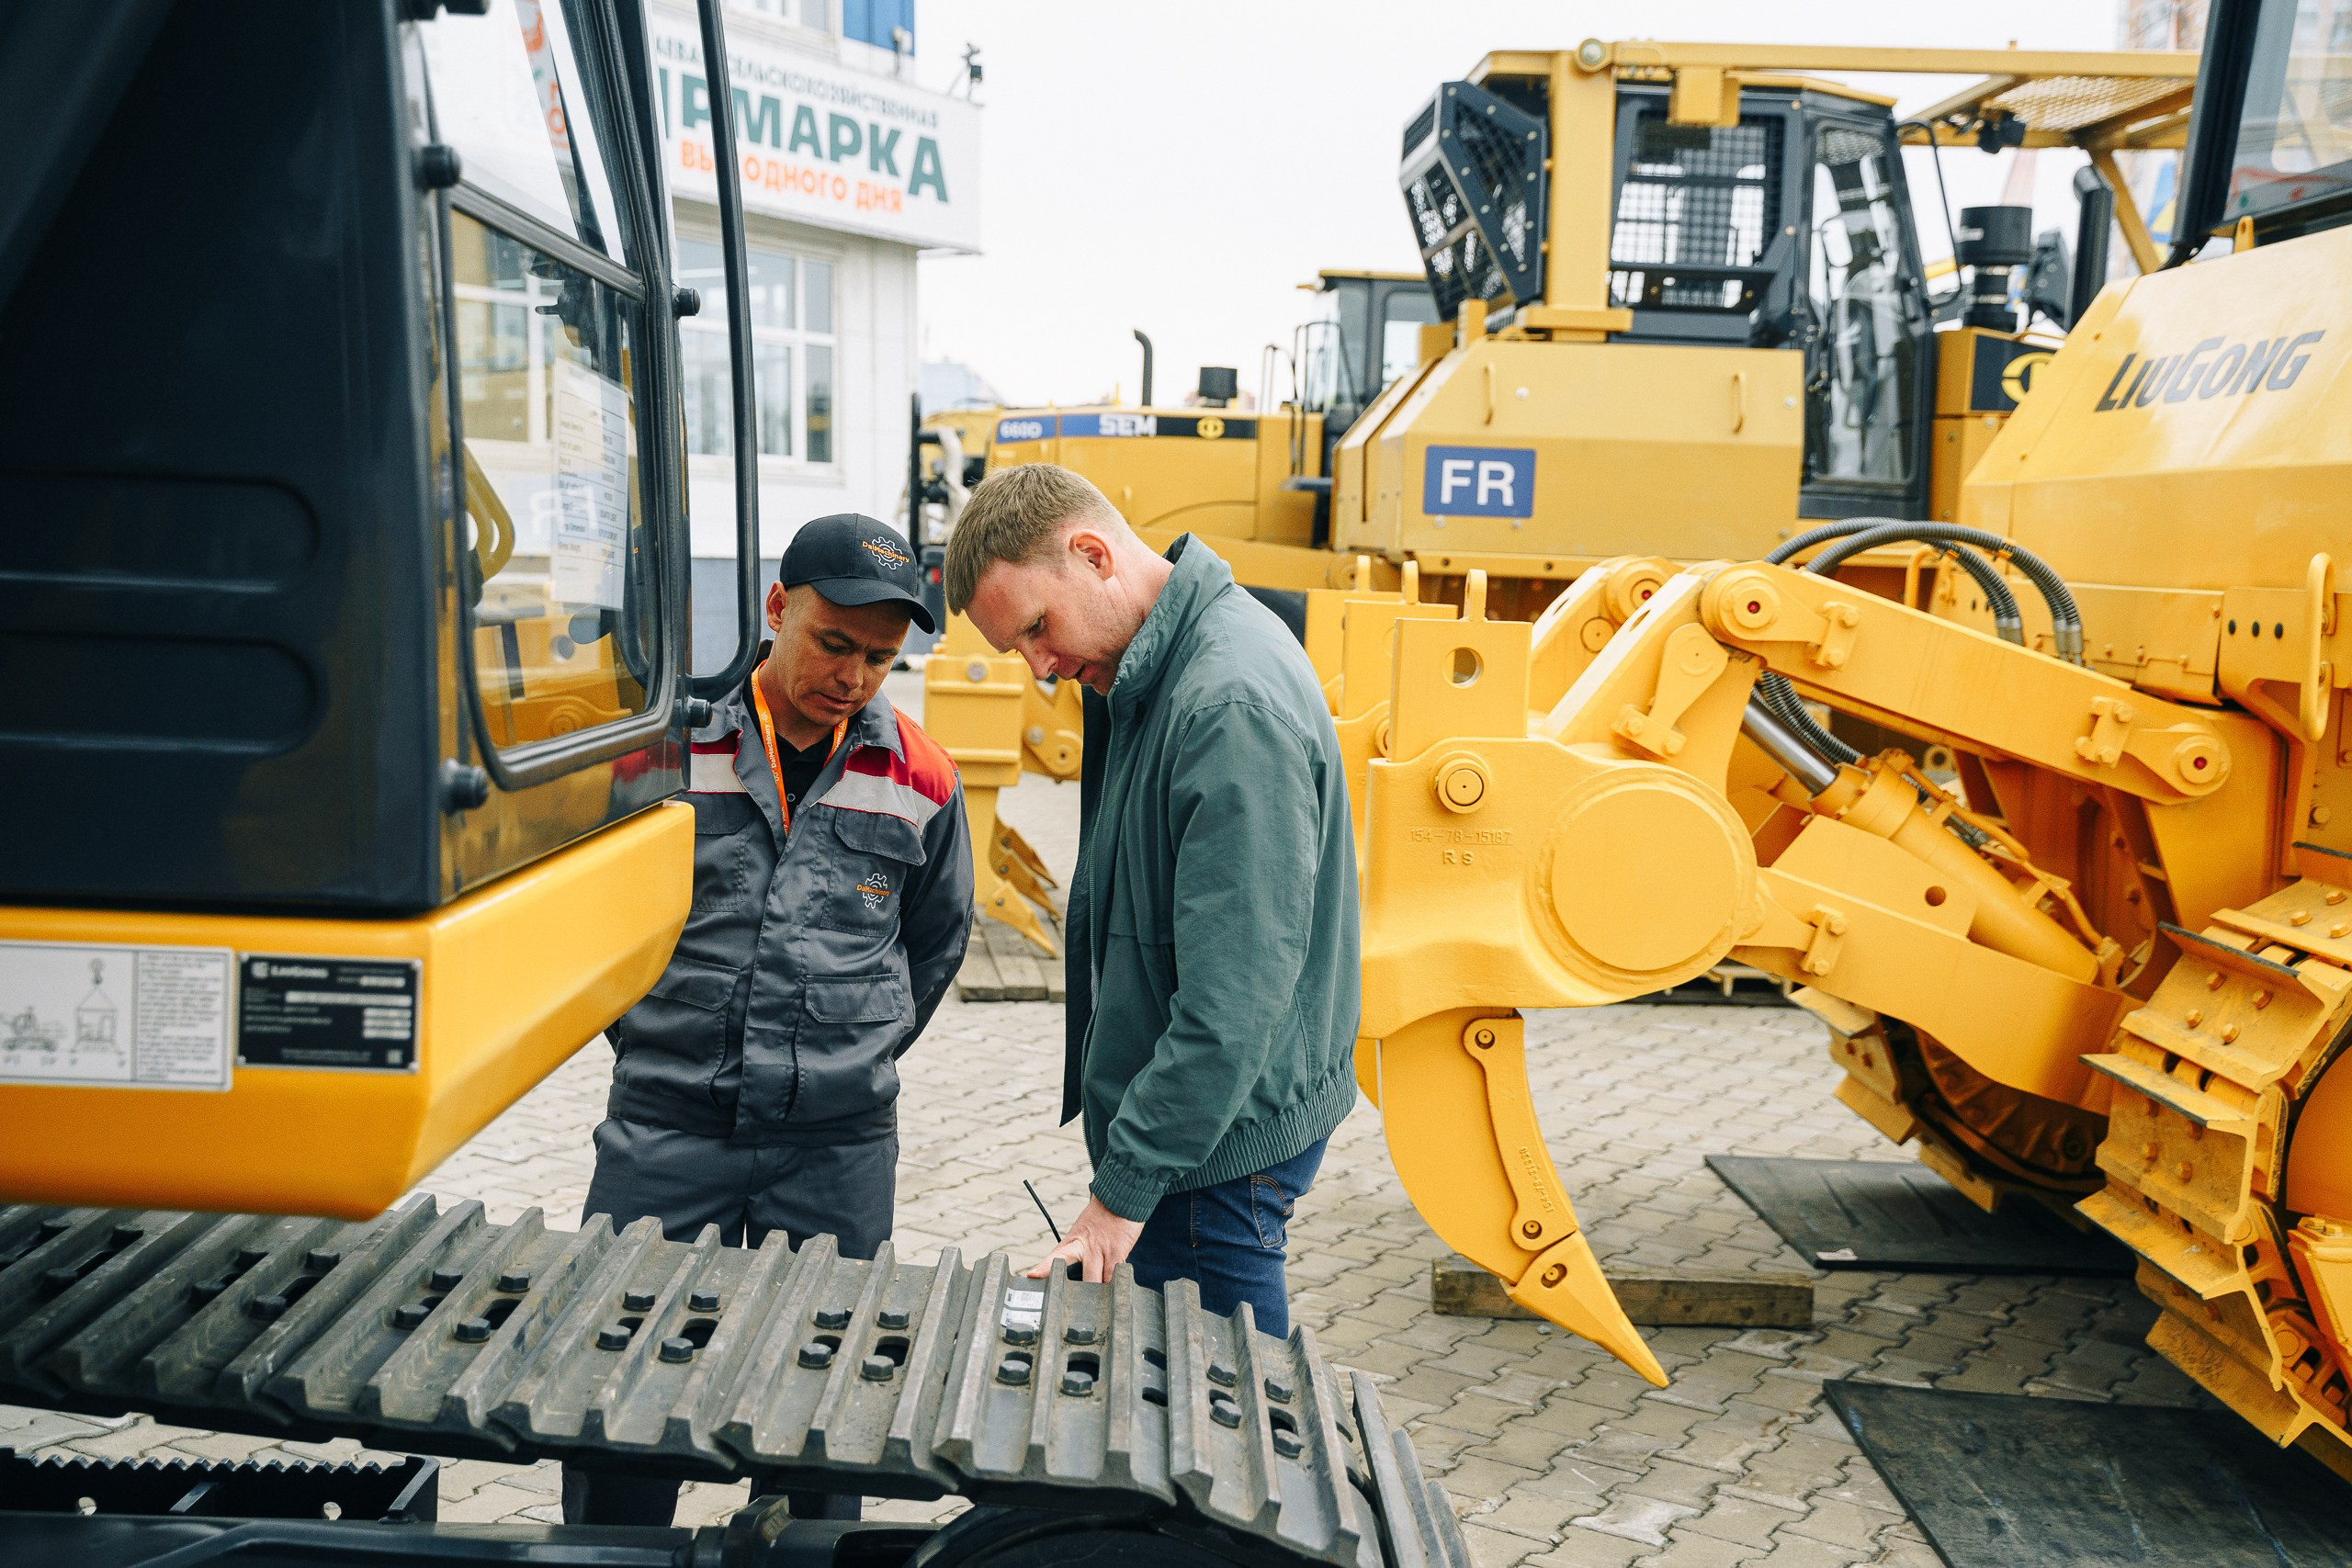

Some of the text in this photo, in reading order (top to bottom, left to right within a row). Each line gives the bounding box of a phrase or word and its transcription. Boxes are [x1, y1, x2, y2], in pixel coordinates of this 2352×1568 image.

[659, 67, 949, 203] РМАРКА
[681, 139, 903, 214] ВЫОДНОГО ДНЯ
[1099, 413, 1158, 437] SEM
[1440, 459, 1516, 507] FR
[763, 724, 777, 769] DalMachinery
